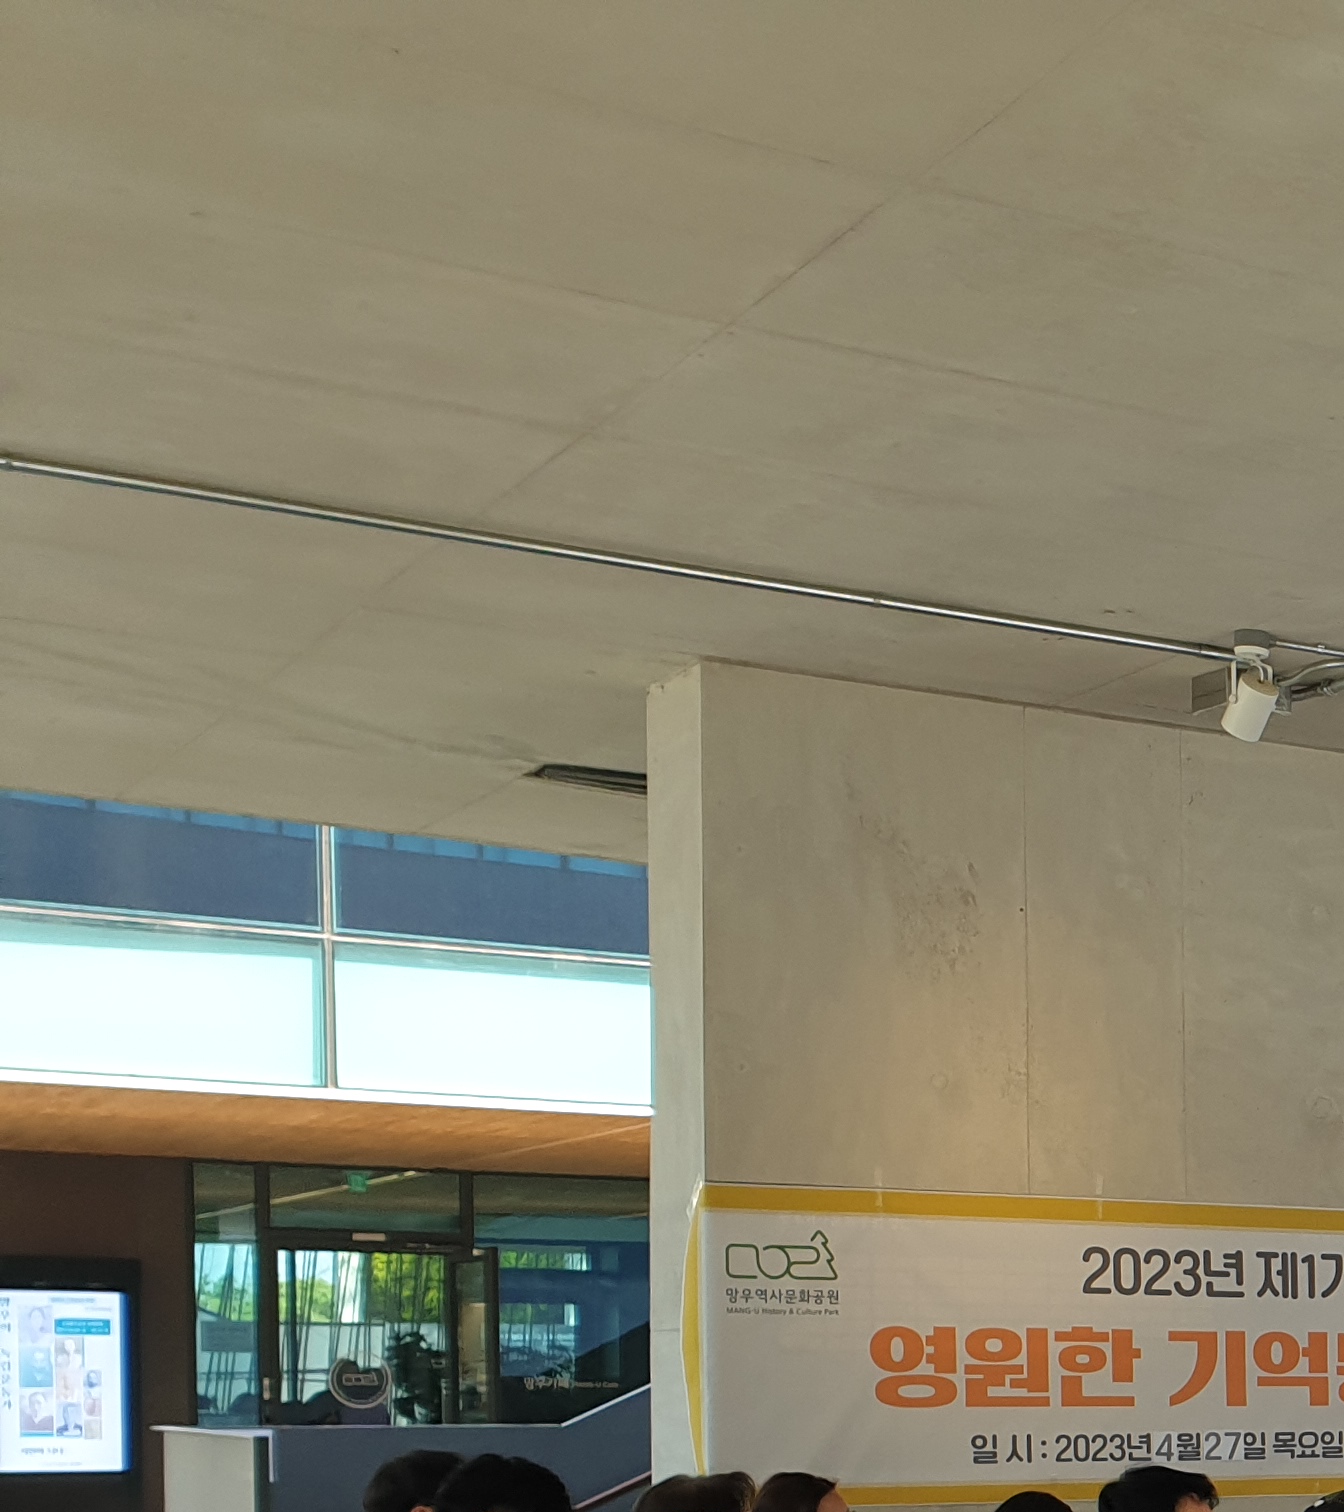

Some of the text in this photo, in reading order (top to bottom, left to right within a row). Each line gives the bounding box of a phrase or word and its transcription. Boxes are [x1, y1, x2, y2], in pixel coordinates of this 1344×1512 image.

[1082, 1246, 1245, 1298] 2023년
[726, 1287, 839, 1305] 망우역사문화공원
[762, 1307, 787, 1317] History
[796, 1308, 822, 1316] Culture
[824, 1308, 840, 1317] Park
[869, 1326, 1142, 1408] 영원한
[1273, 1430, 1344, 1460] 목요일
